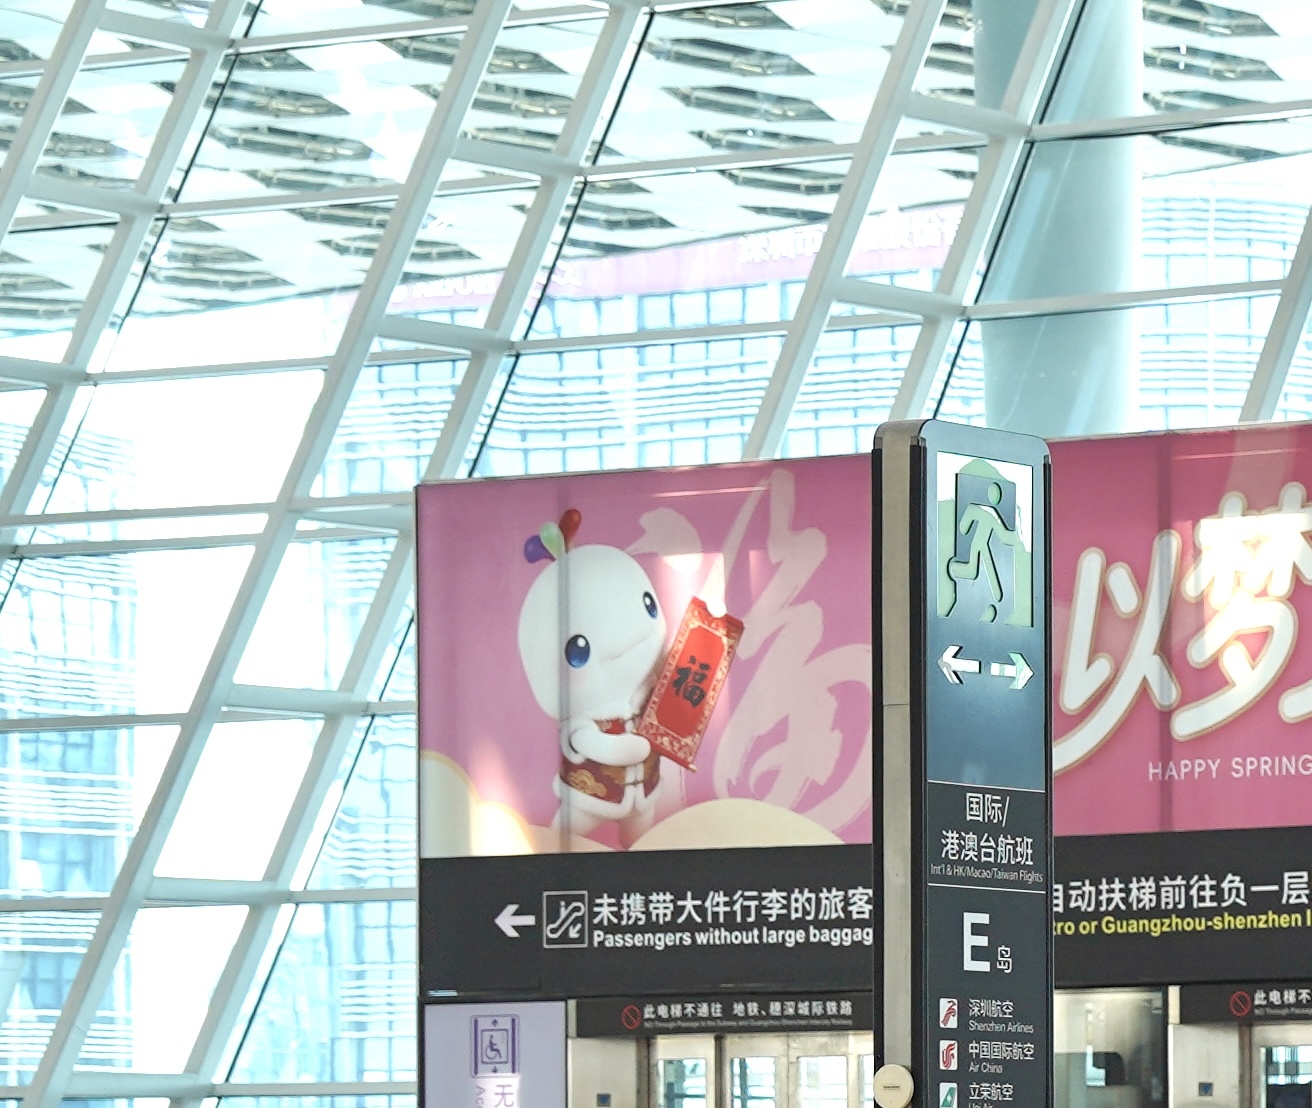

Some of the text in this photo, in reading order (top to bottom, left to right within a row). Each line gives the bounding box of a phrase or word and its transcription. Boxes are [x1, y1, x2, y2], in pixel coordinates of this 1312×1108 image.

[672, 655, 711, 711] 福
[1148, 758, 1221, 783] HAPPY
[965, 792, 1010, 828] 国际/
[940, 829, 1034, 866] 港澳台航班
[1019, 869, 1044, 884] Flights
[592, 886, 874, 927] 未携带大件行李的旅客
[1079, 918, 1098, 935] or
[1101, 911, 1302, 938] Guangzhou-shenzhen
[592, 925, 874, 950] Passengers without large baggag
[963, 911, 1012, 973] E 岛
[643, 1002, 723, 1020] 此电梯不通往
[968, 998, 1014, 1018] 深圳航空
[968, 1020, 1034, 1034] Shenzhen Airlines
[968, 1040, 1035, 1060] 中国国际航空
[968, 1062, 1003, 1074] Air China
[968, 1082, 1014, 1101] 立荣航空
